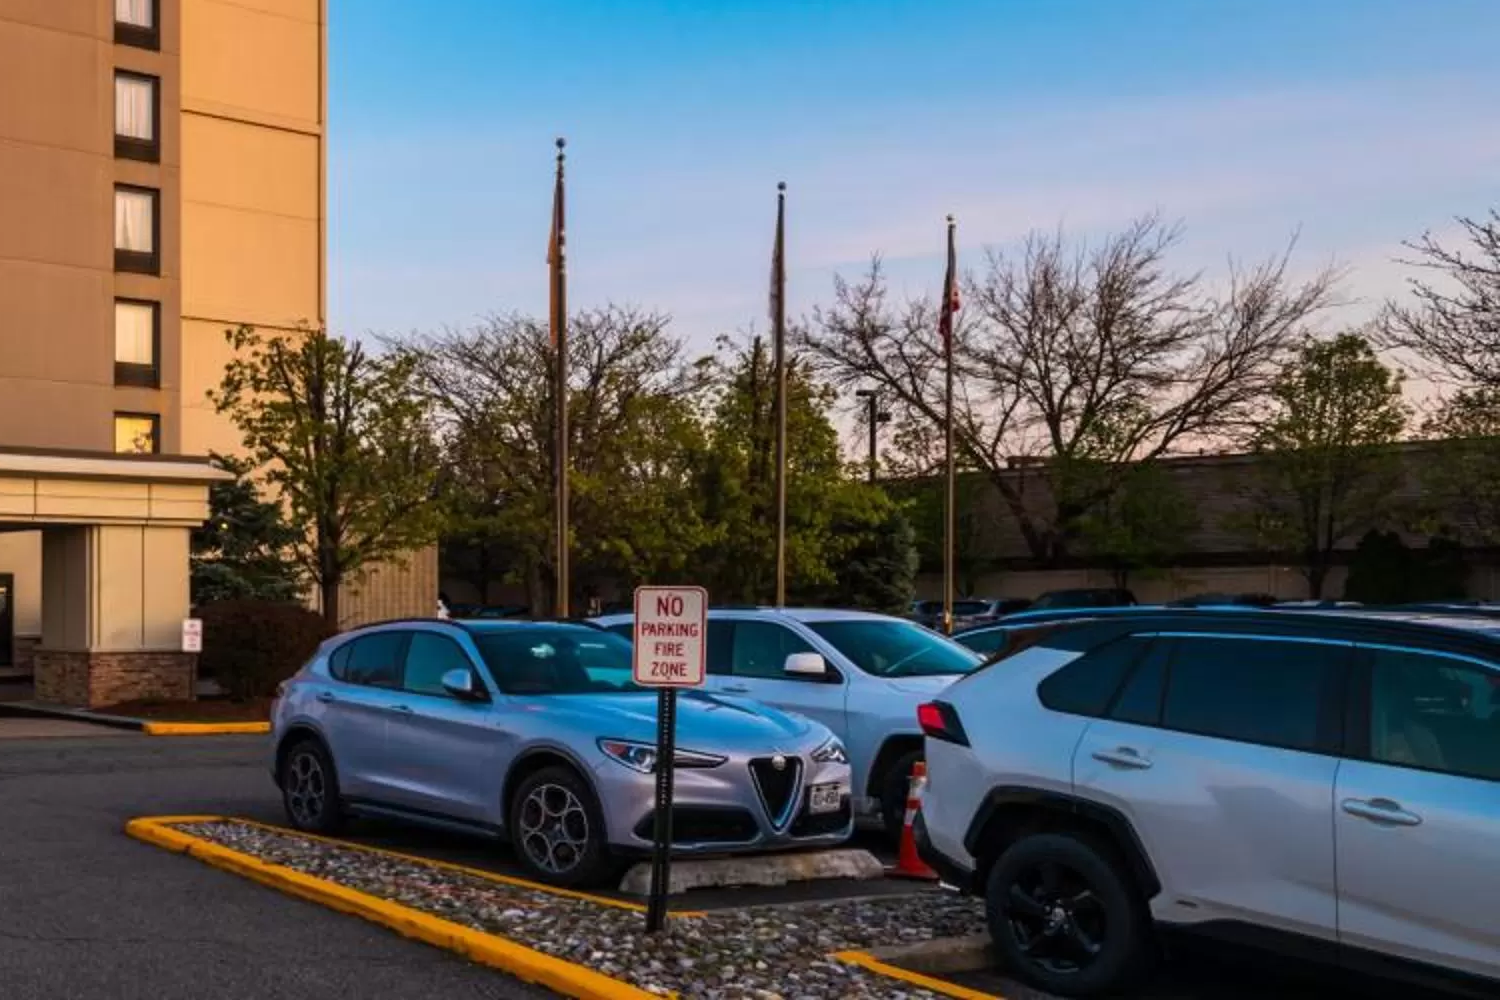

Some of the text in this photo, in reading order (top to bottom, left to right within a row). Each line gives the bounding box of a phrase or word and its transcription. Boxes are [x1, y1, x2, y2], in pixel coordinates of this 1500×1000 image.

[656, 596, 684, 617] NO
[641, 622, 698, 638] PARKING
[654, 641, 684, 656] FIRE
[651, 661, 688, 677] ZONE
